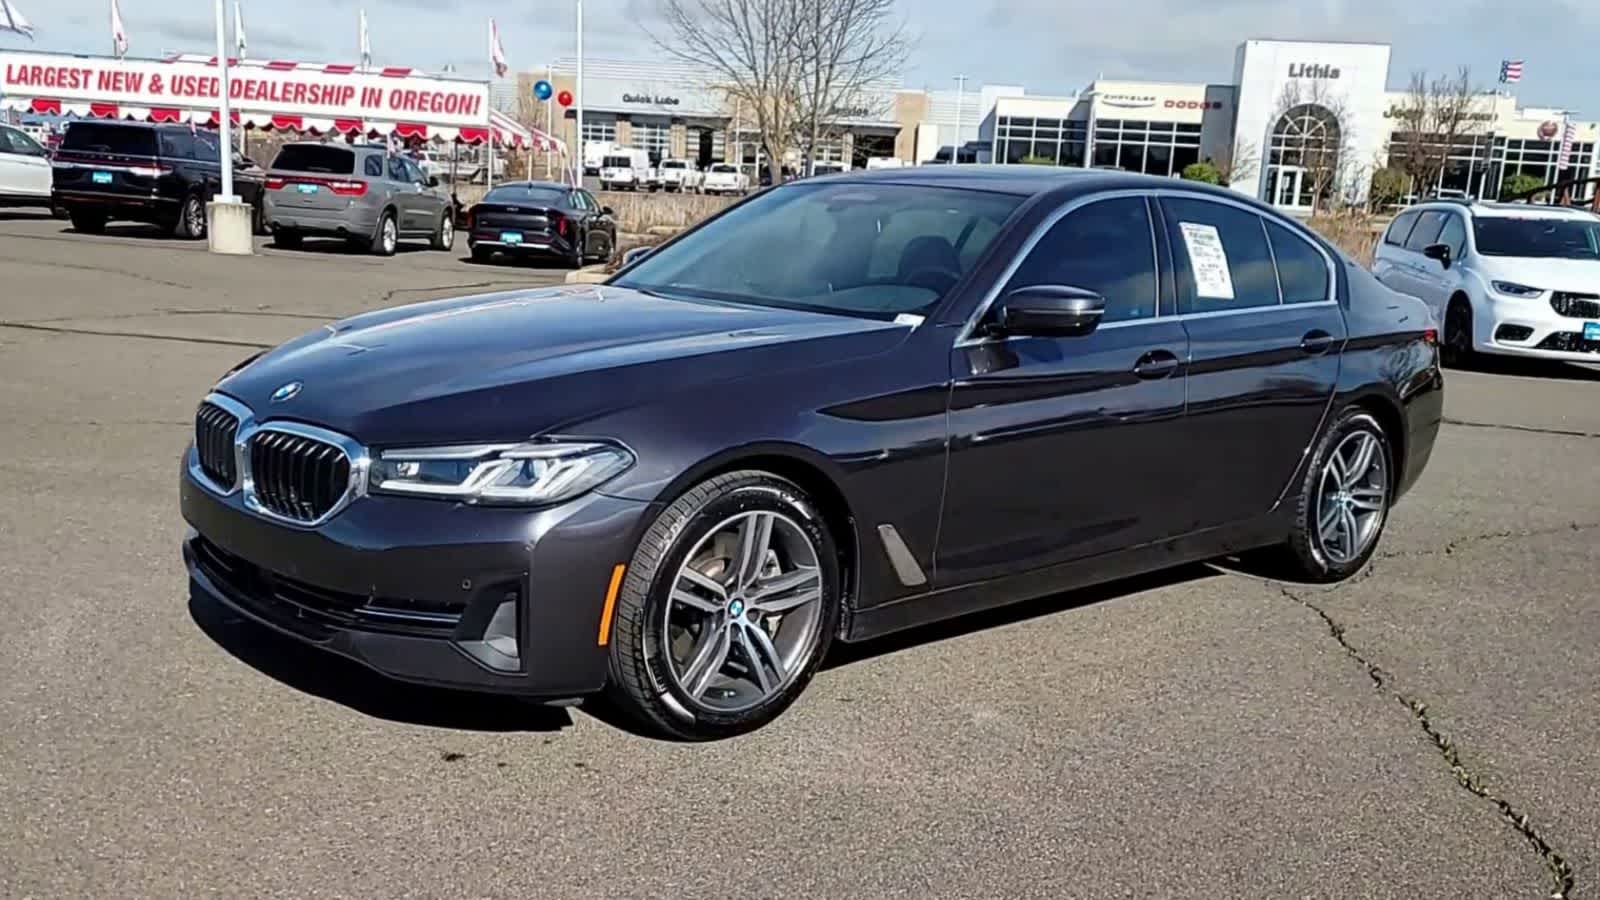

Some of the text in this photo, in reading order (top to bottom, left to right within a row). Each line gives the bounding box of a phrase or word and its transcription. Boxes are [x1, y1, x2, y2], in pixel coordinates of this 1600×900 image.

[1288, 62, 1341, 80] Lithia
[6, 64, 482, 115] LARGEST NEW & USED DEALERSHIP IN OREGON!
[622, 93, 679, 105] Quick Lube
